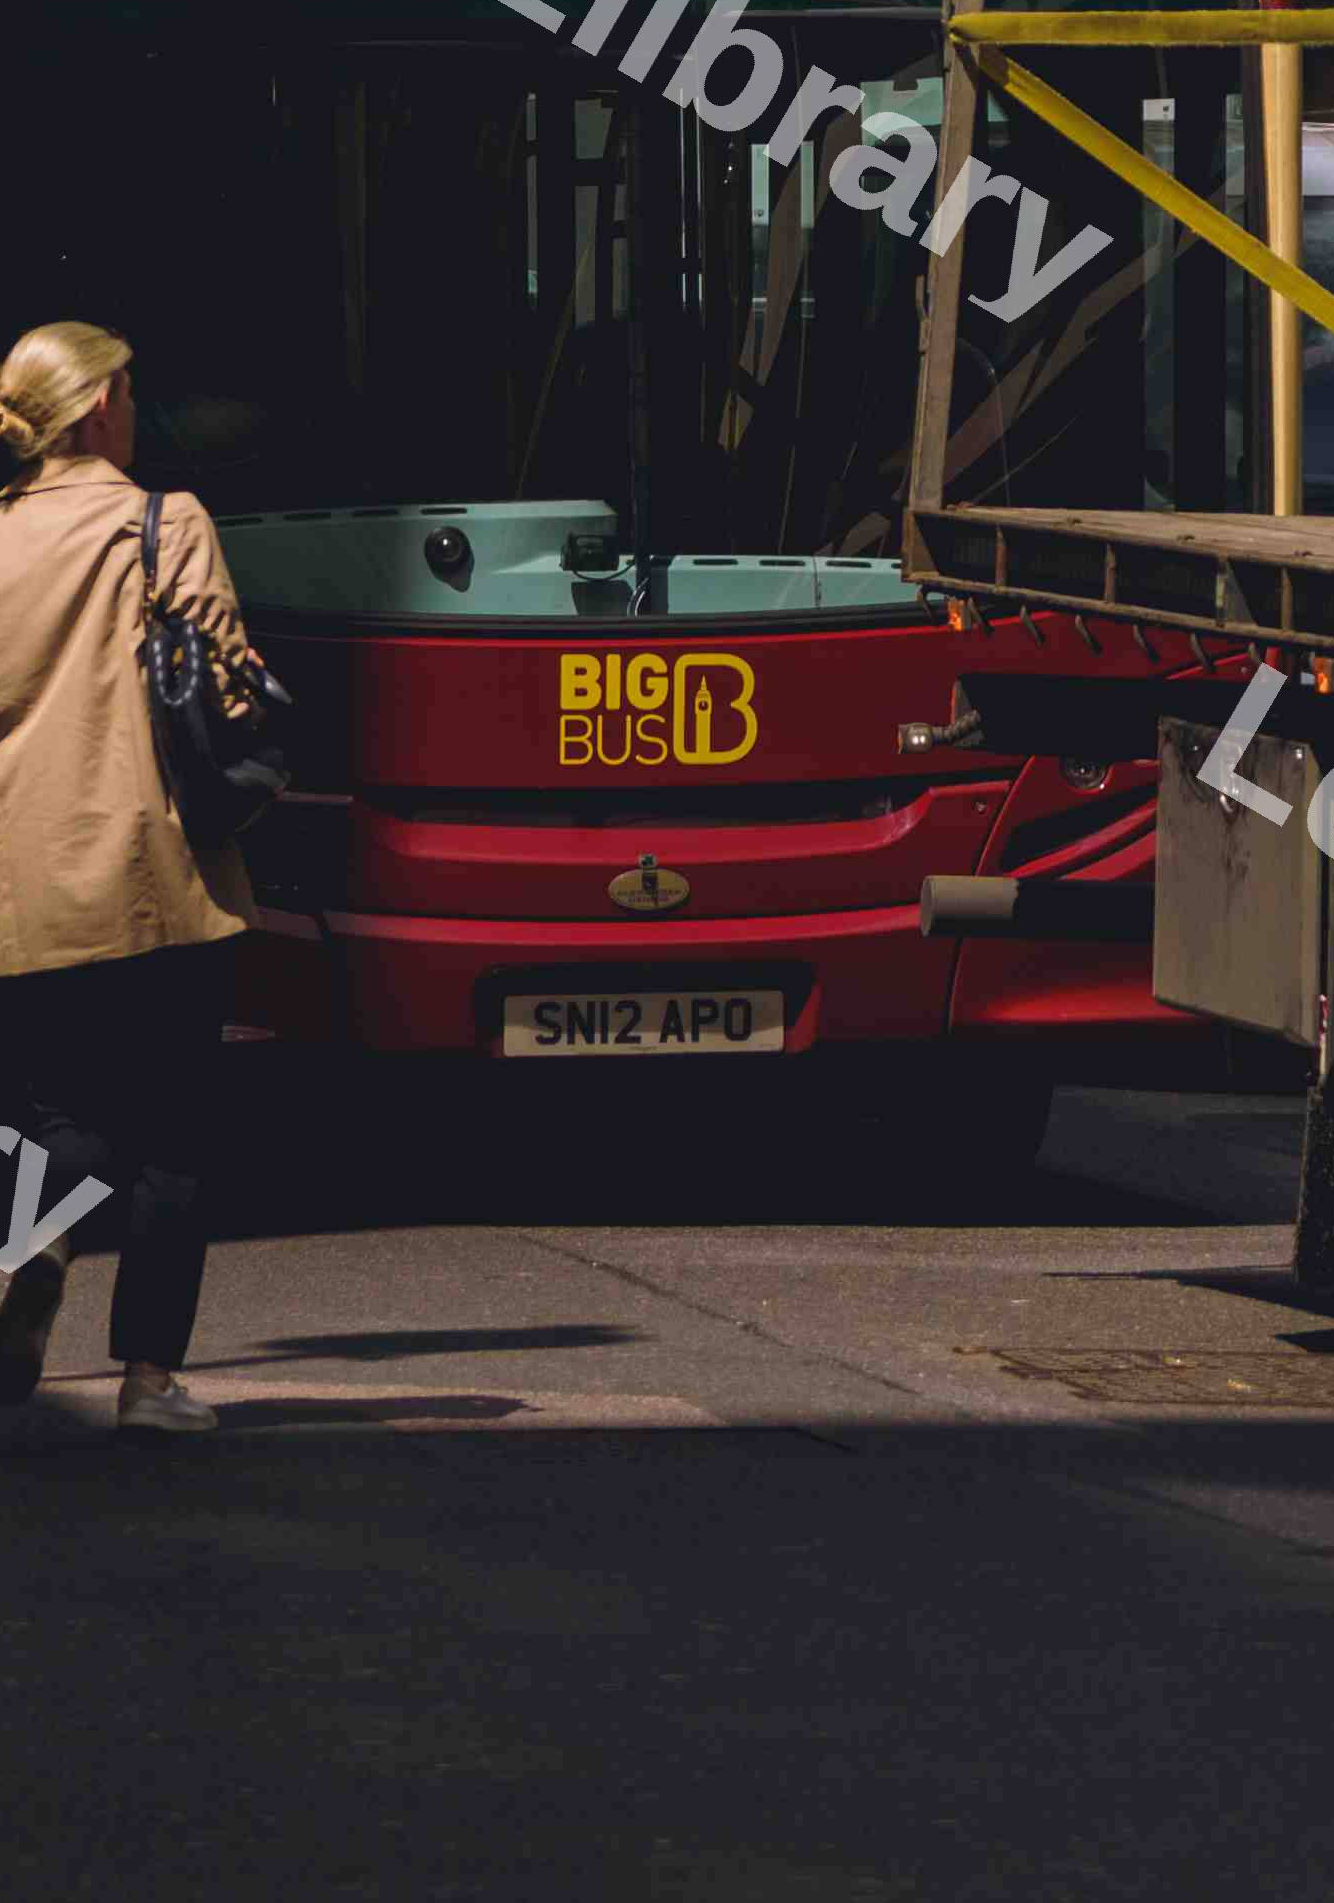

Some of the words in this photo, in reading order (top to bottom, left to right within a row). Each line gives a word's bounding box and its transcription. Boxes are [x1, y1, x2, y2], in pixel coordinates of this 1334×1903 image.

[560, 653, 668, 710] BIG
[560, 714, 668, 765] BUS
[533, 999, 642, 1046] SN12
[659, 998, 753, 1043] APO
